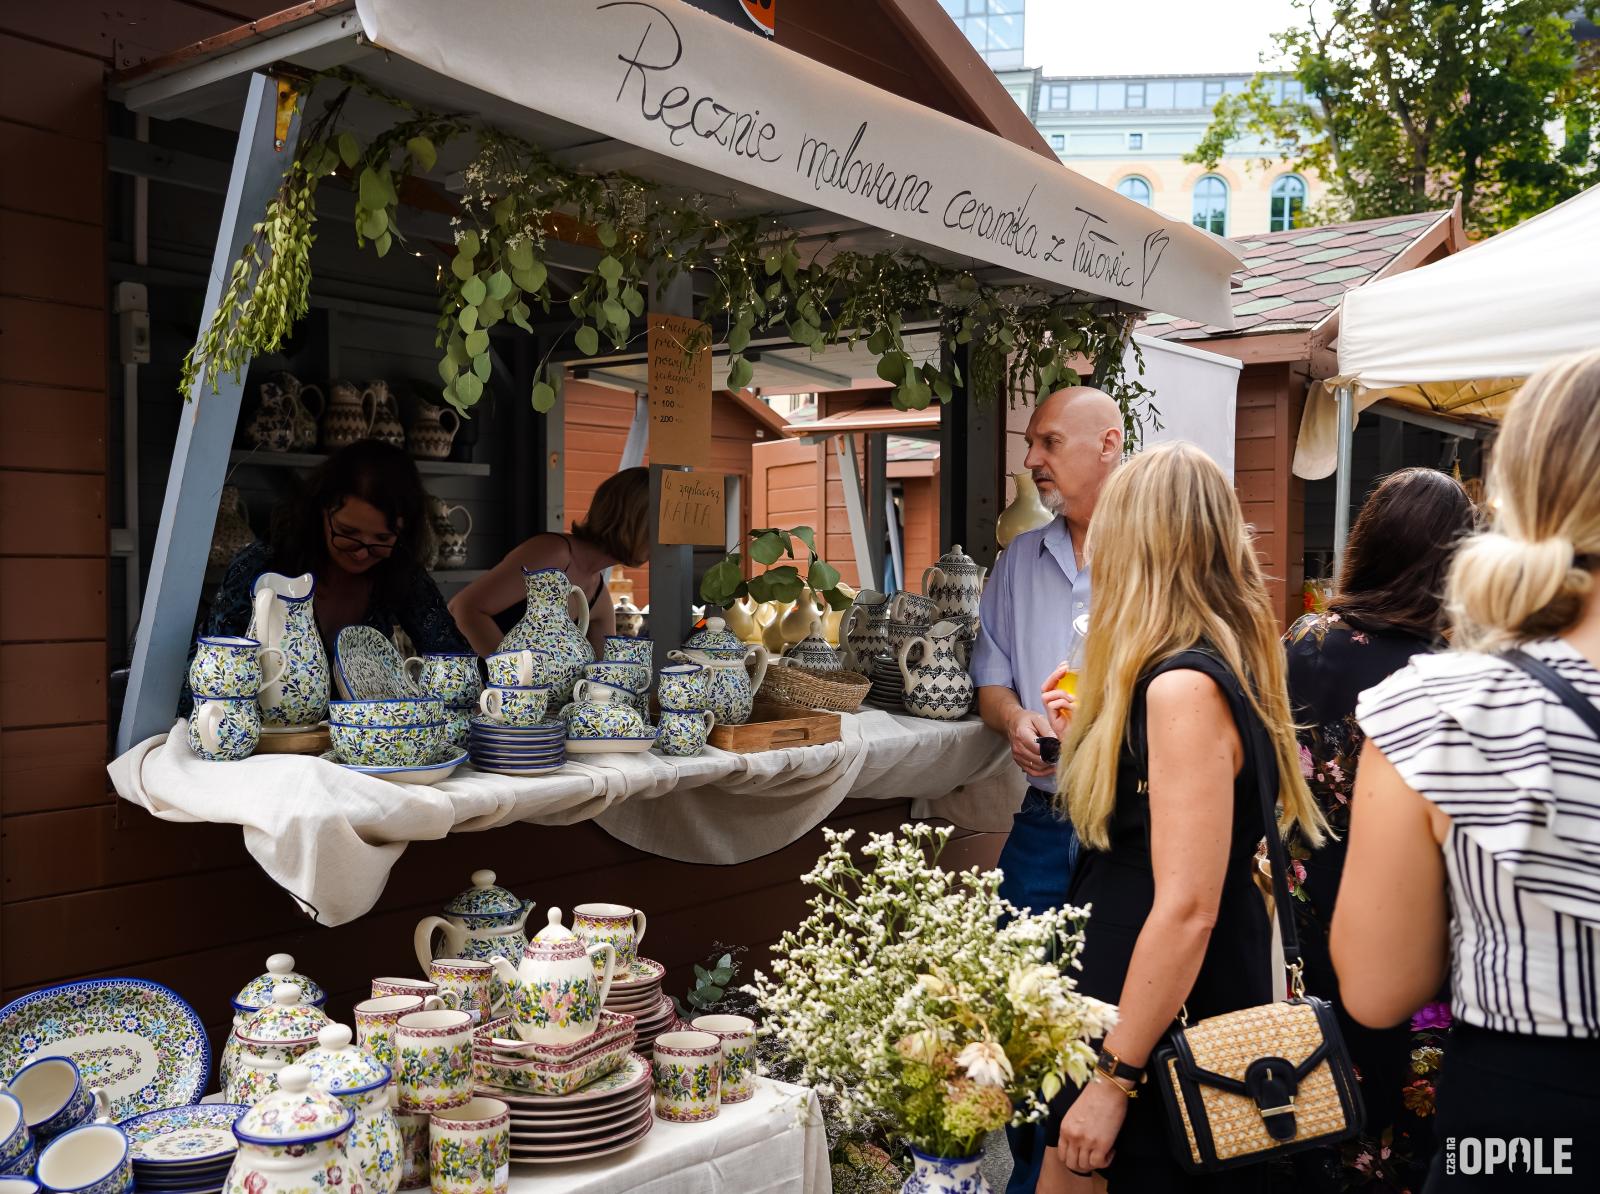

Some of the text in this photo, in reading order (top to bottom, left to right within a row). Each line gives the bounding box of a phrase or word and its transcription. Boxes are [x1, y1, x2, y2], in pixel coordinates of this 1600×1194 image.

[597, 1, 783, 162] Ręcznie
[797, 121, 933, 214] malowana
[943, 183, 1038, 260] ceramika
[1043, 235, 1065, 263] z
[661, 399, 675, 409] 100
[659, 415, 674, 424] 200
